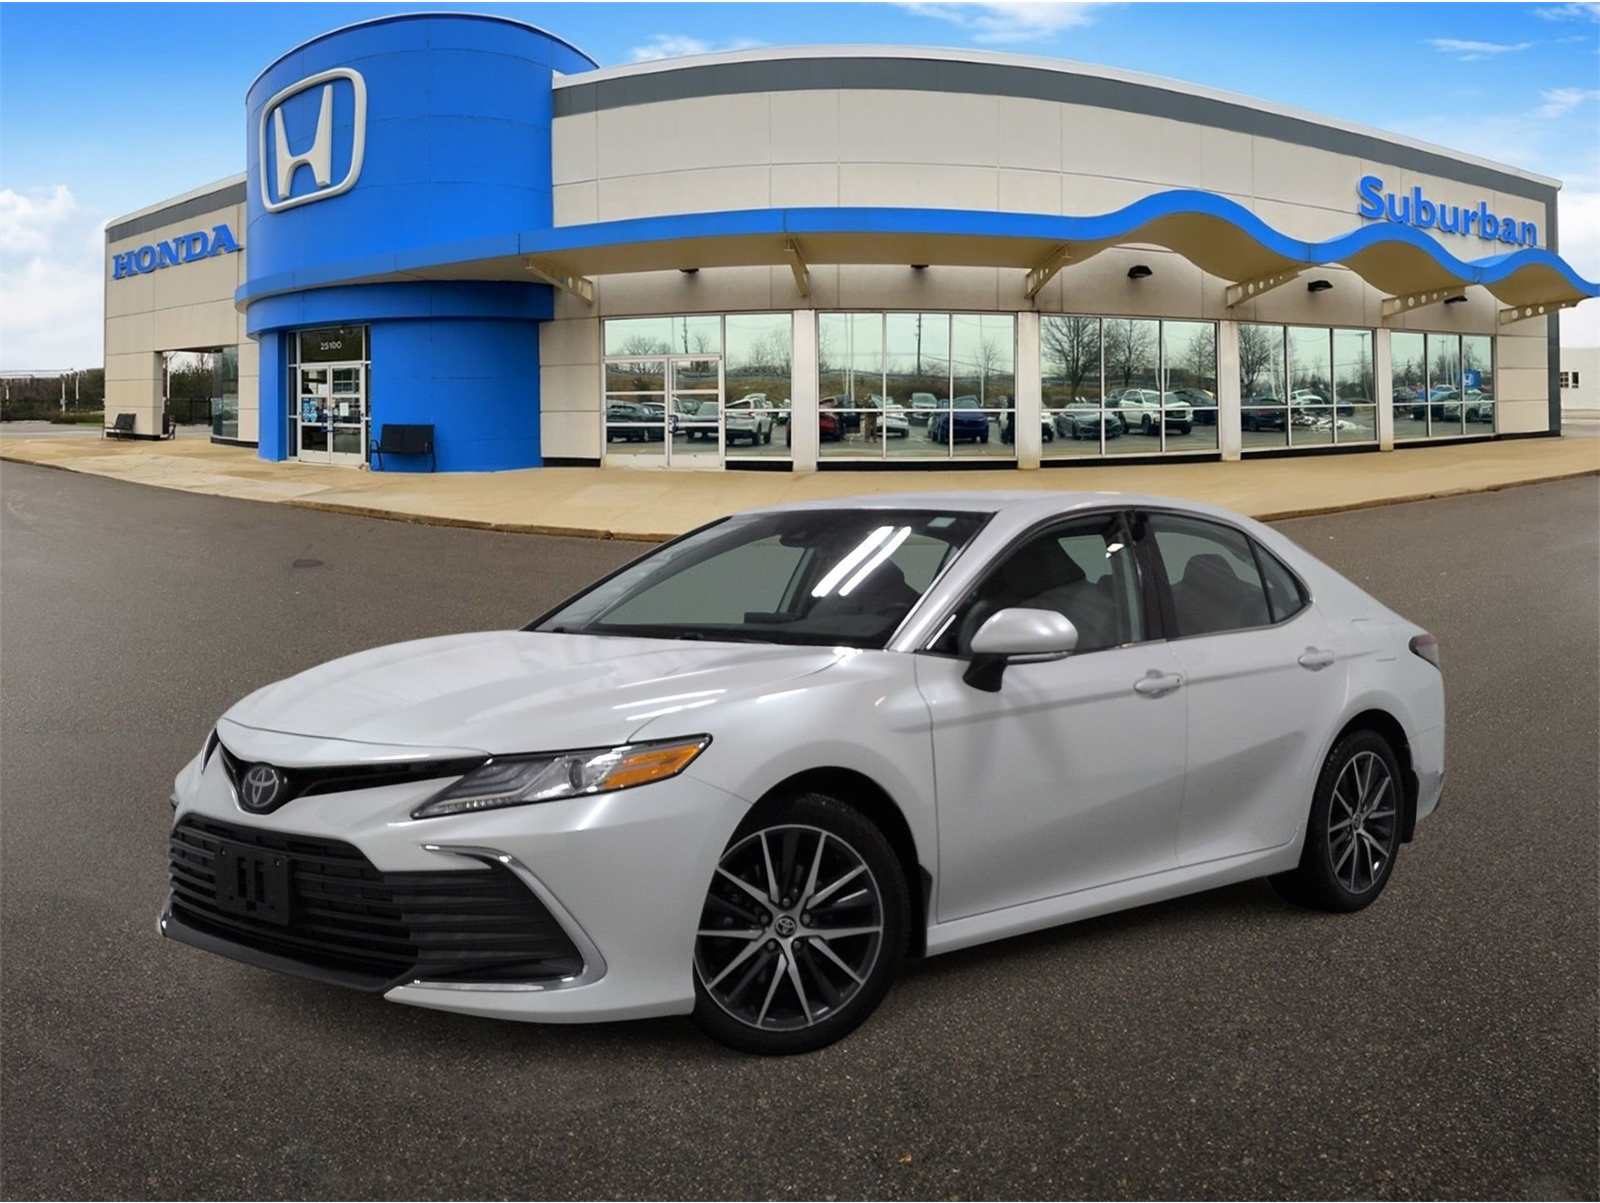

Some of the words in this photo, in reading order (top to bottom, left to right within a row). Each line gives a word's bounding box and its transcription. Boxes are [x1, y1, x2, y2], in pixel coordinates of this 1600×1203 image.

[1358, 175, 1538, 247] Suburban
[112, 223, 241, 280] HONDA
[320, 340, 343, 350] 25100
